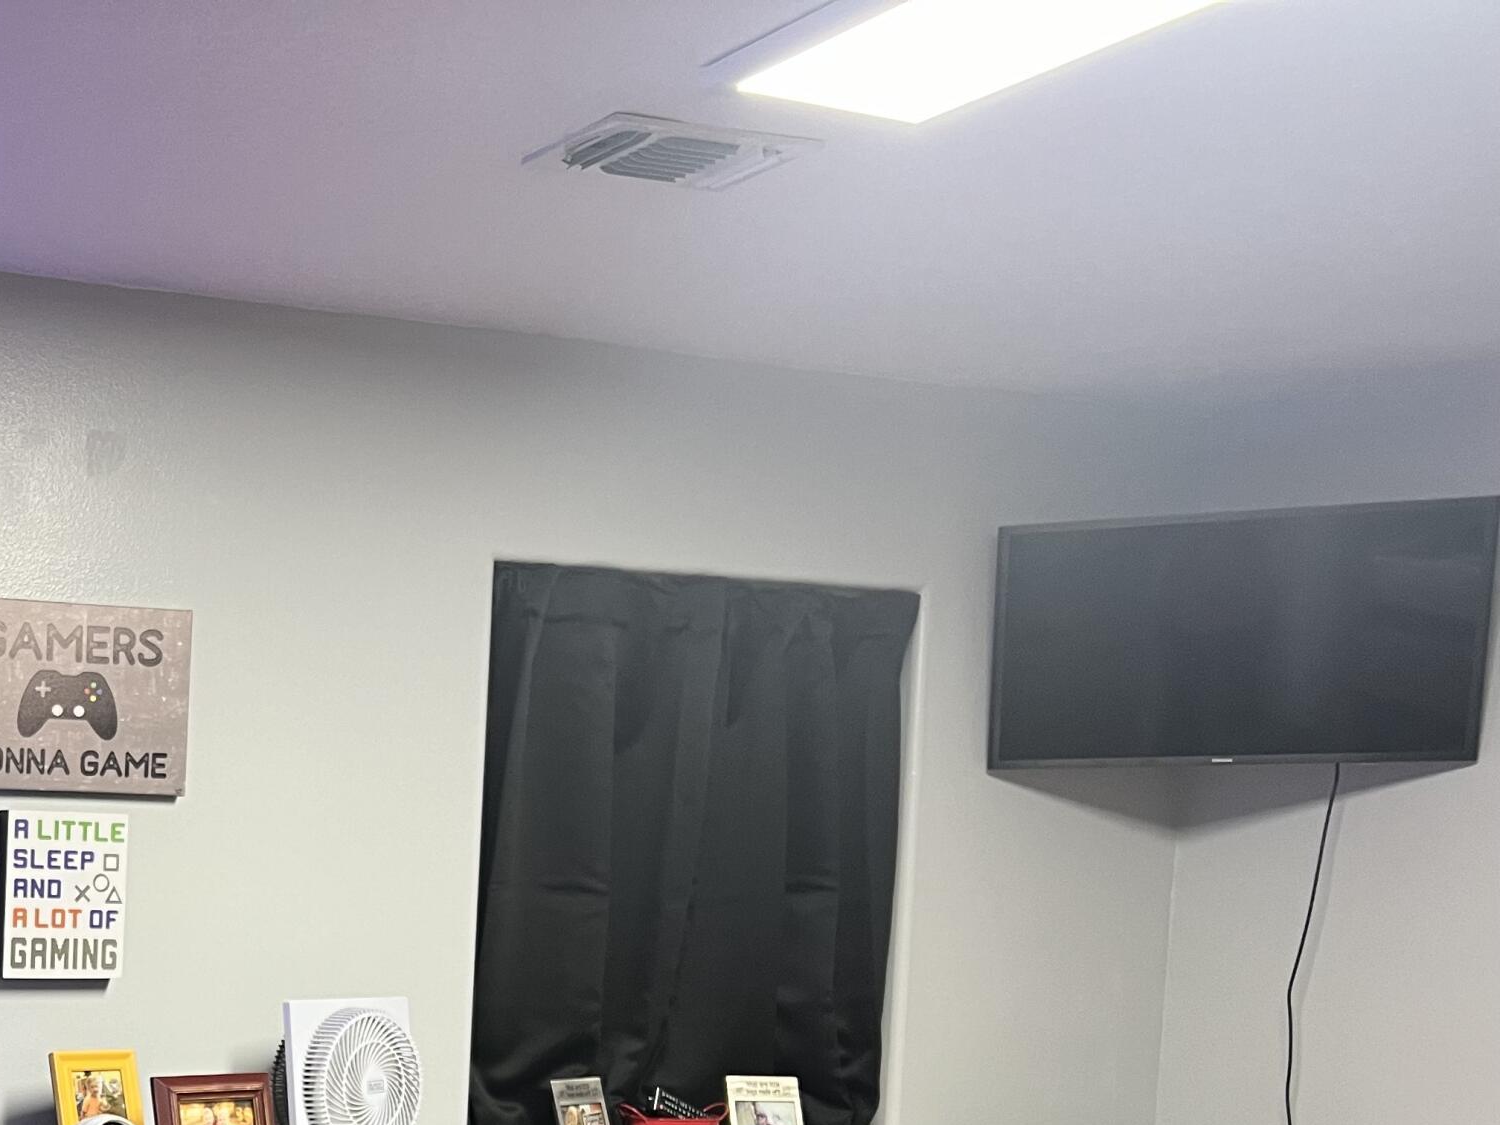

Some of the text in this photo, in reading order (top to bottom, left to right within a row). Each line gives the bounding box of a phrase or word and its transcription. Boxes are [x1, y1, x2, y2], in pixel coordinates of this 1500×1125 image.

[80, 750, 168, 779] GAME
[14, 819, 125, 843] A LITTLE
[13, 849, 95, 870] SLEEP
[13, 878, 62, 899] AND
[12, 907, 120, 930] A LOT OF
[10, 937, 118, 971] GAMING
